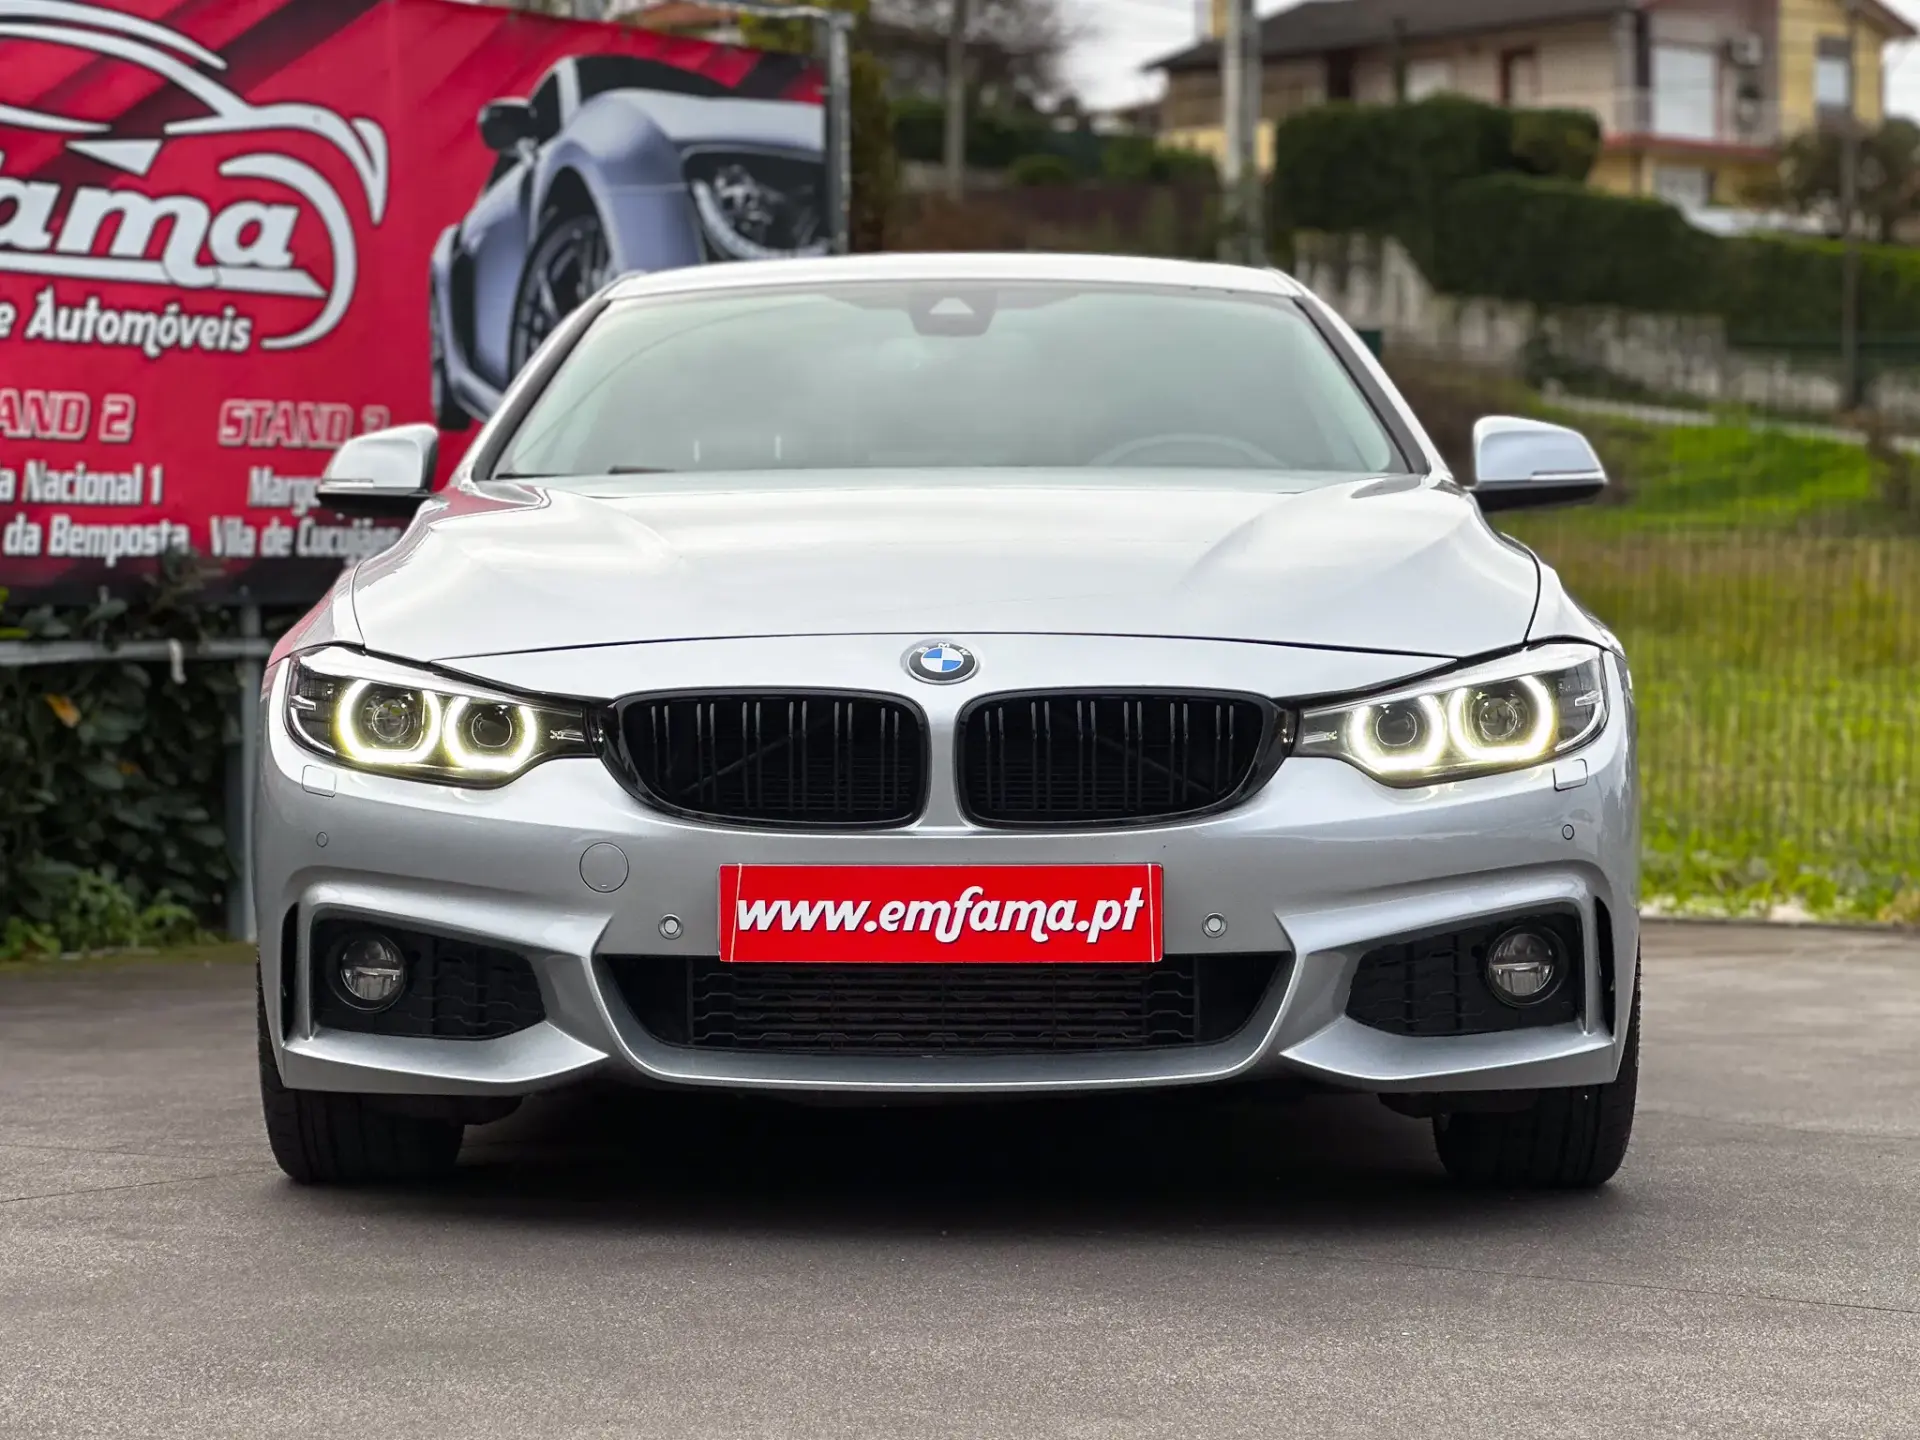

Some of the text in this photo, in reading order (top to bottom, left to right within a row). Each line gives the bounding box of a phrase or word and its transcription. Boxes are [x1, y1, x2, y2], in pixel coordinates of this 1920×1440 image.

[0, 166, 300, 288] ama
[25, 284, 251, 357] Automóveis
[98, 393, 136, 443] 2
[218, 398, 353, 450] STAND
[23, 459, 144, 504] Nacional
[3, 512, 190, 568] da Bemposta
[209, 514, 256, 557] Vila
[260, 516, 294, 557] de
[737, 886, 1144, 943] www.emfama.pt
